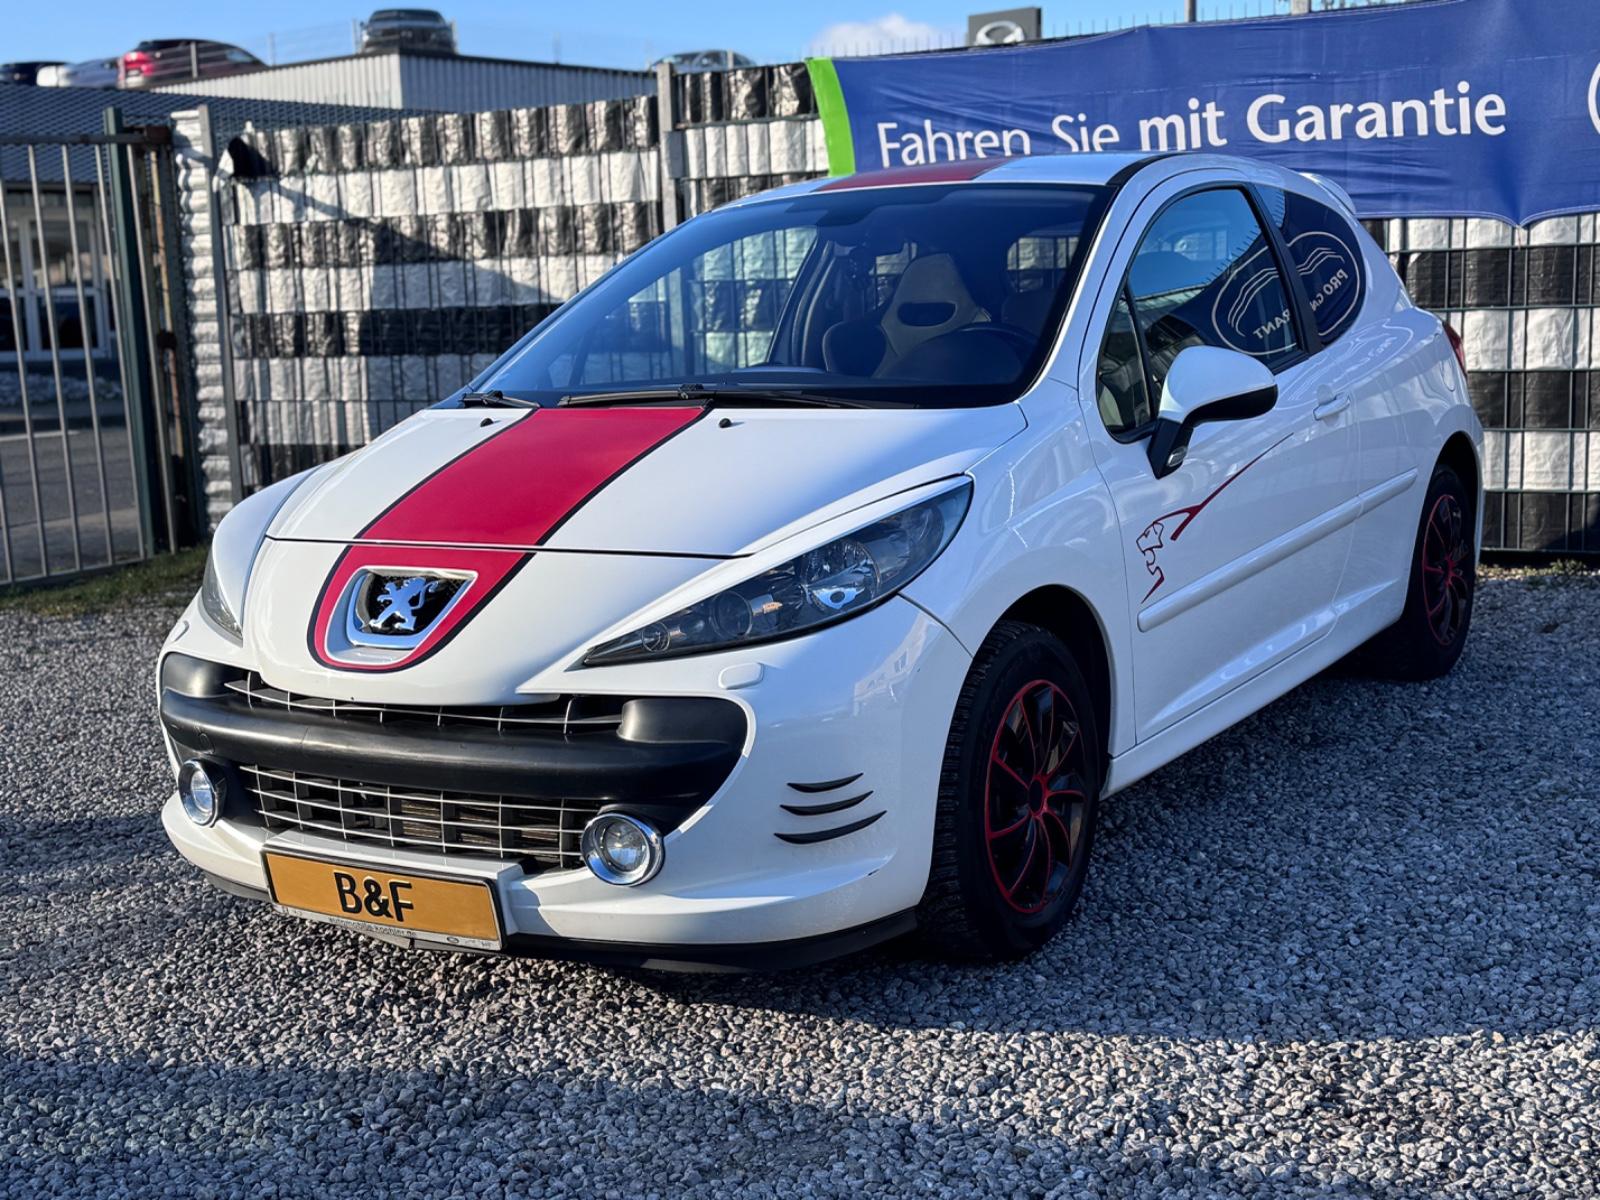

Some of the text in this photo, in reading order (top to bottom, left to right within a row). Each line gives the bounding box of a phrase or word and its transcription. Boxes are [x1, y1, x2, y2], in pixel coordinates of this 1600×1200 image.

[877, 80, 1507, 169] Fahren Sie mit Garantie
[333, 871, 414, 922] B&F
